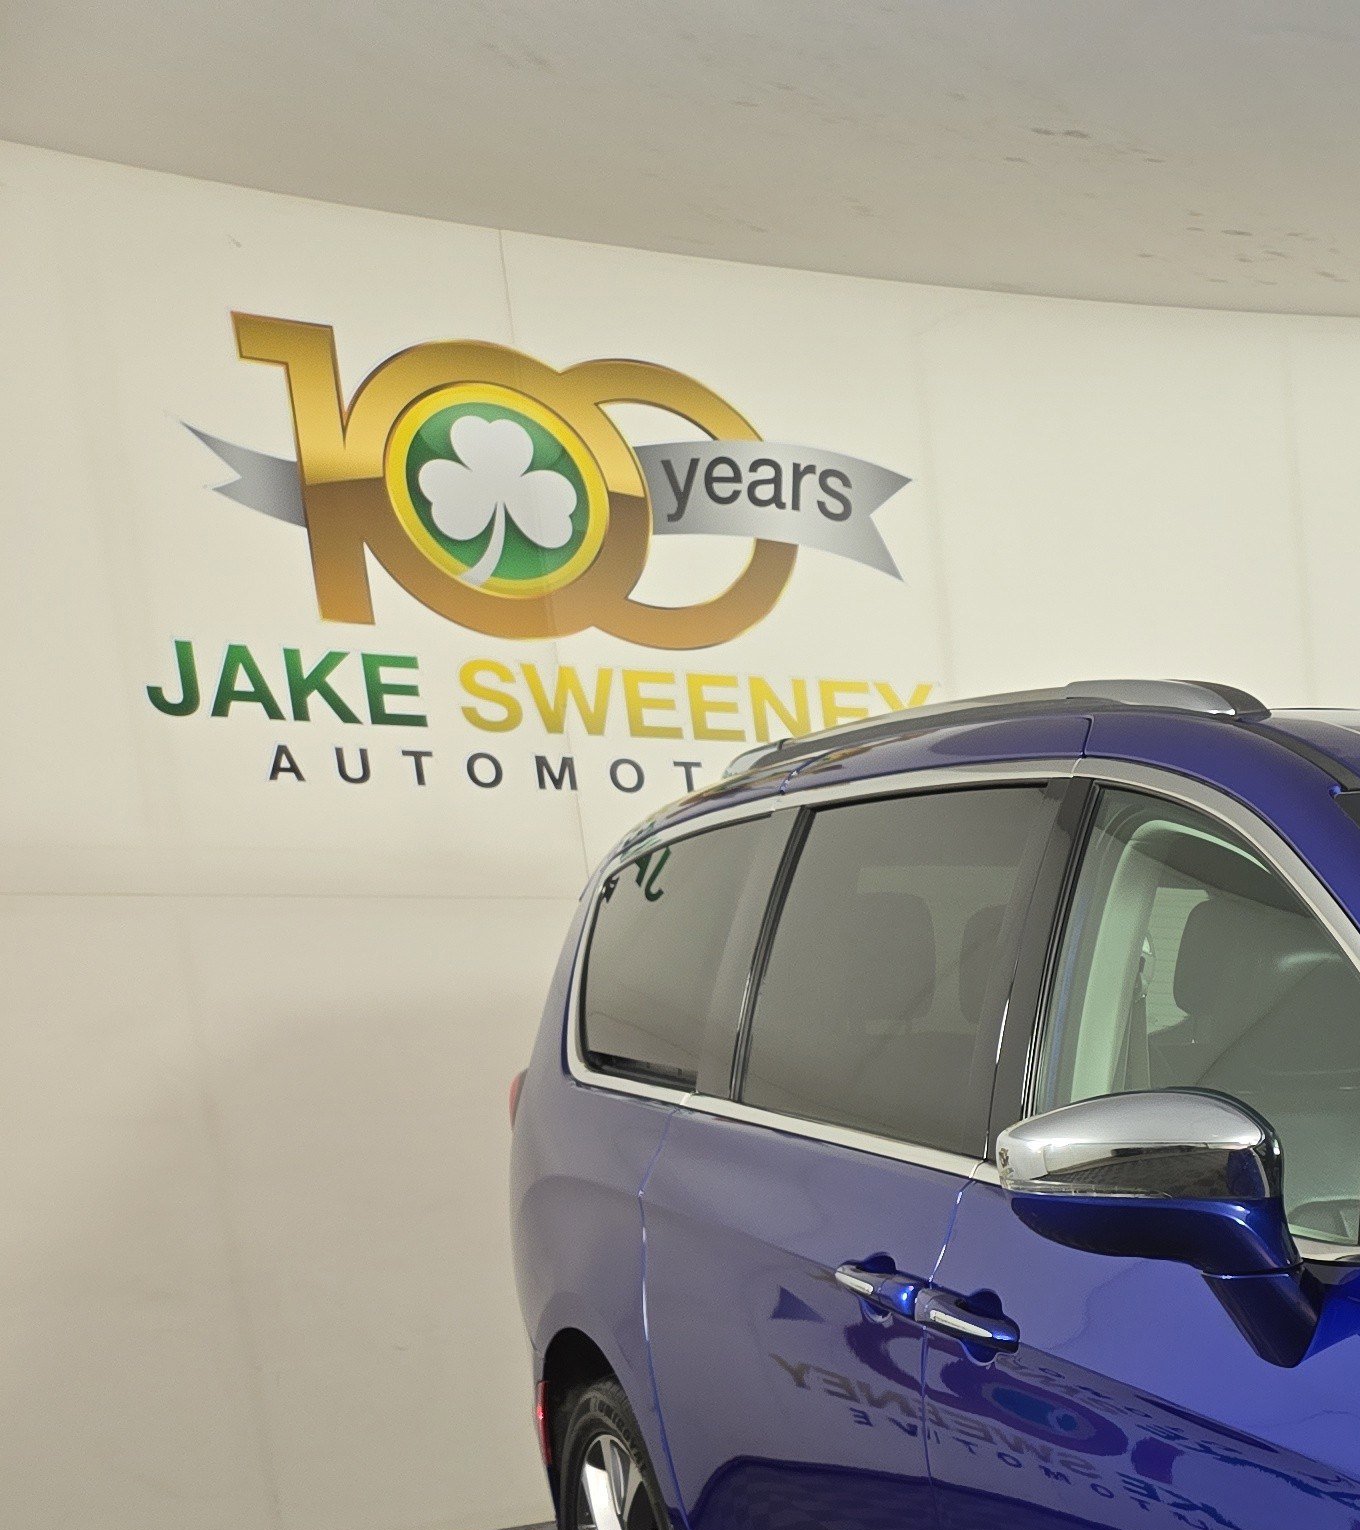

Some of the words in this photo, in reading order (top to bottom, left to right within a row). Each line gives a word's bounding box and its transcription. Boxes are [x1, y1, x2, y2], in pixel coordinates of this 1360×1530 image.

[231, 310, 798, 650] 100
[661, 454, 855, 525] years
[145, 638, 429, 728] JAKE
[269, 743, 702, 793] AUTOMOT
